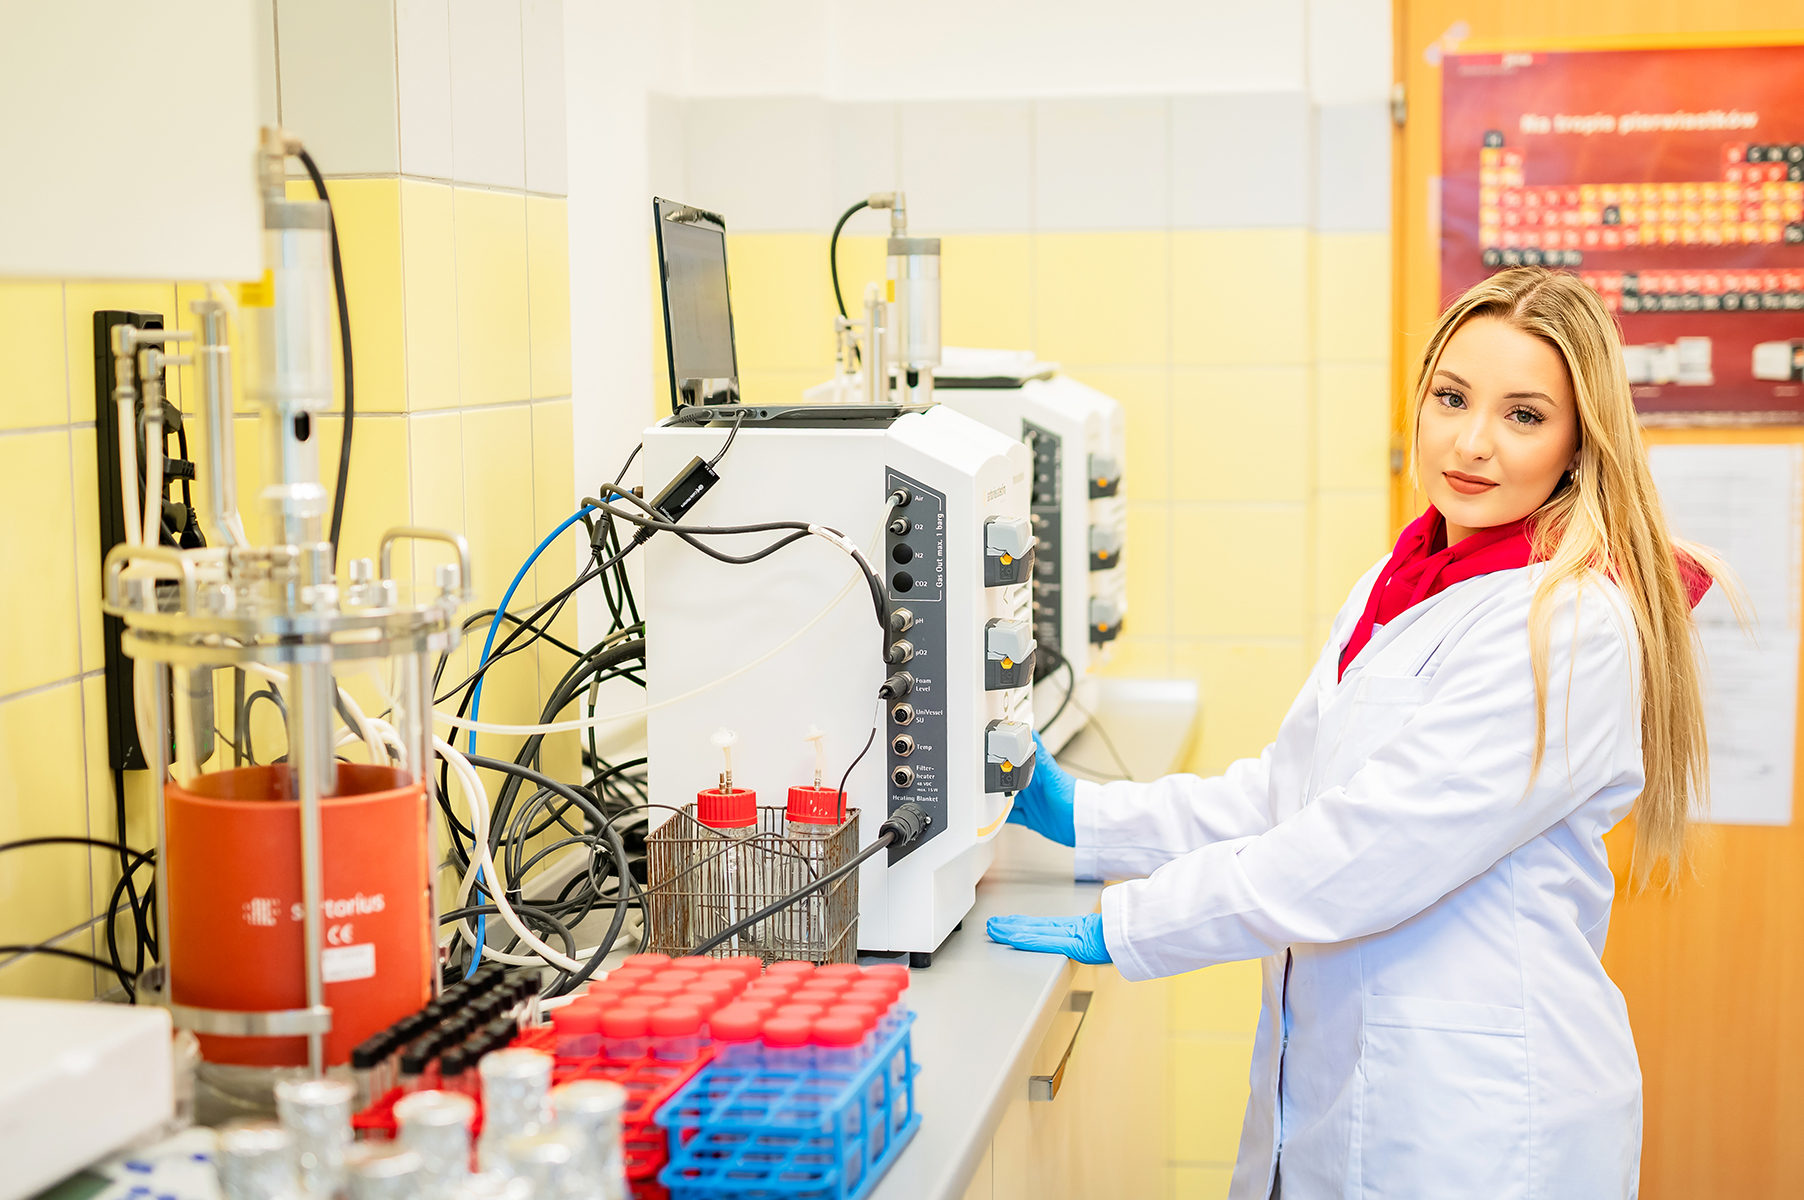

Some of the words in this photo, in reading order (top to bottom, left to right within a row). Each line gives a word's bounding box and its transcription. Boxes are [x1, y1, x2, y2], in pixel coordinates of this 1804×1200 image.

[936, 513, 945, 531] barg
[914, 580, 928, 588] CO2
[915, 617, 924, 625] pH
[915, 649, 928, 657] pO2
[916, 743, 933, 752] Temp
[892, 794, 916, 802] Heating
[916, 795, 939, 803] Blanket
